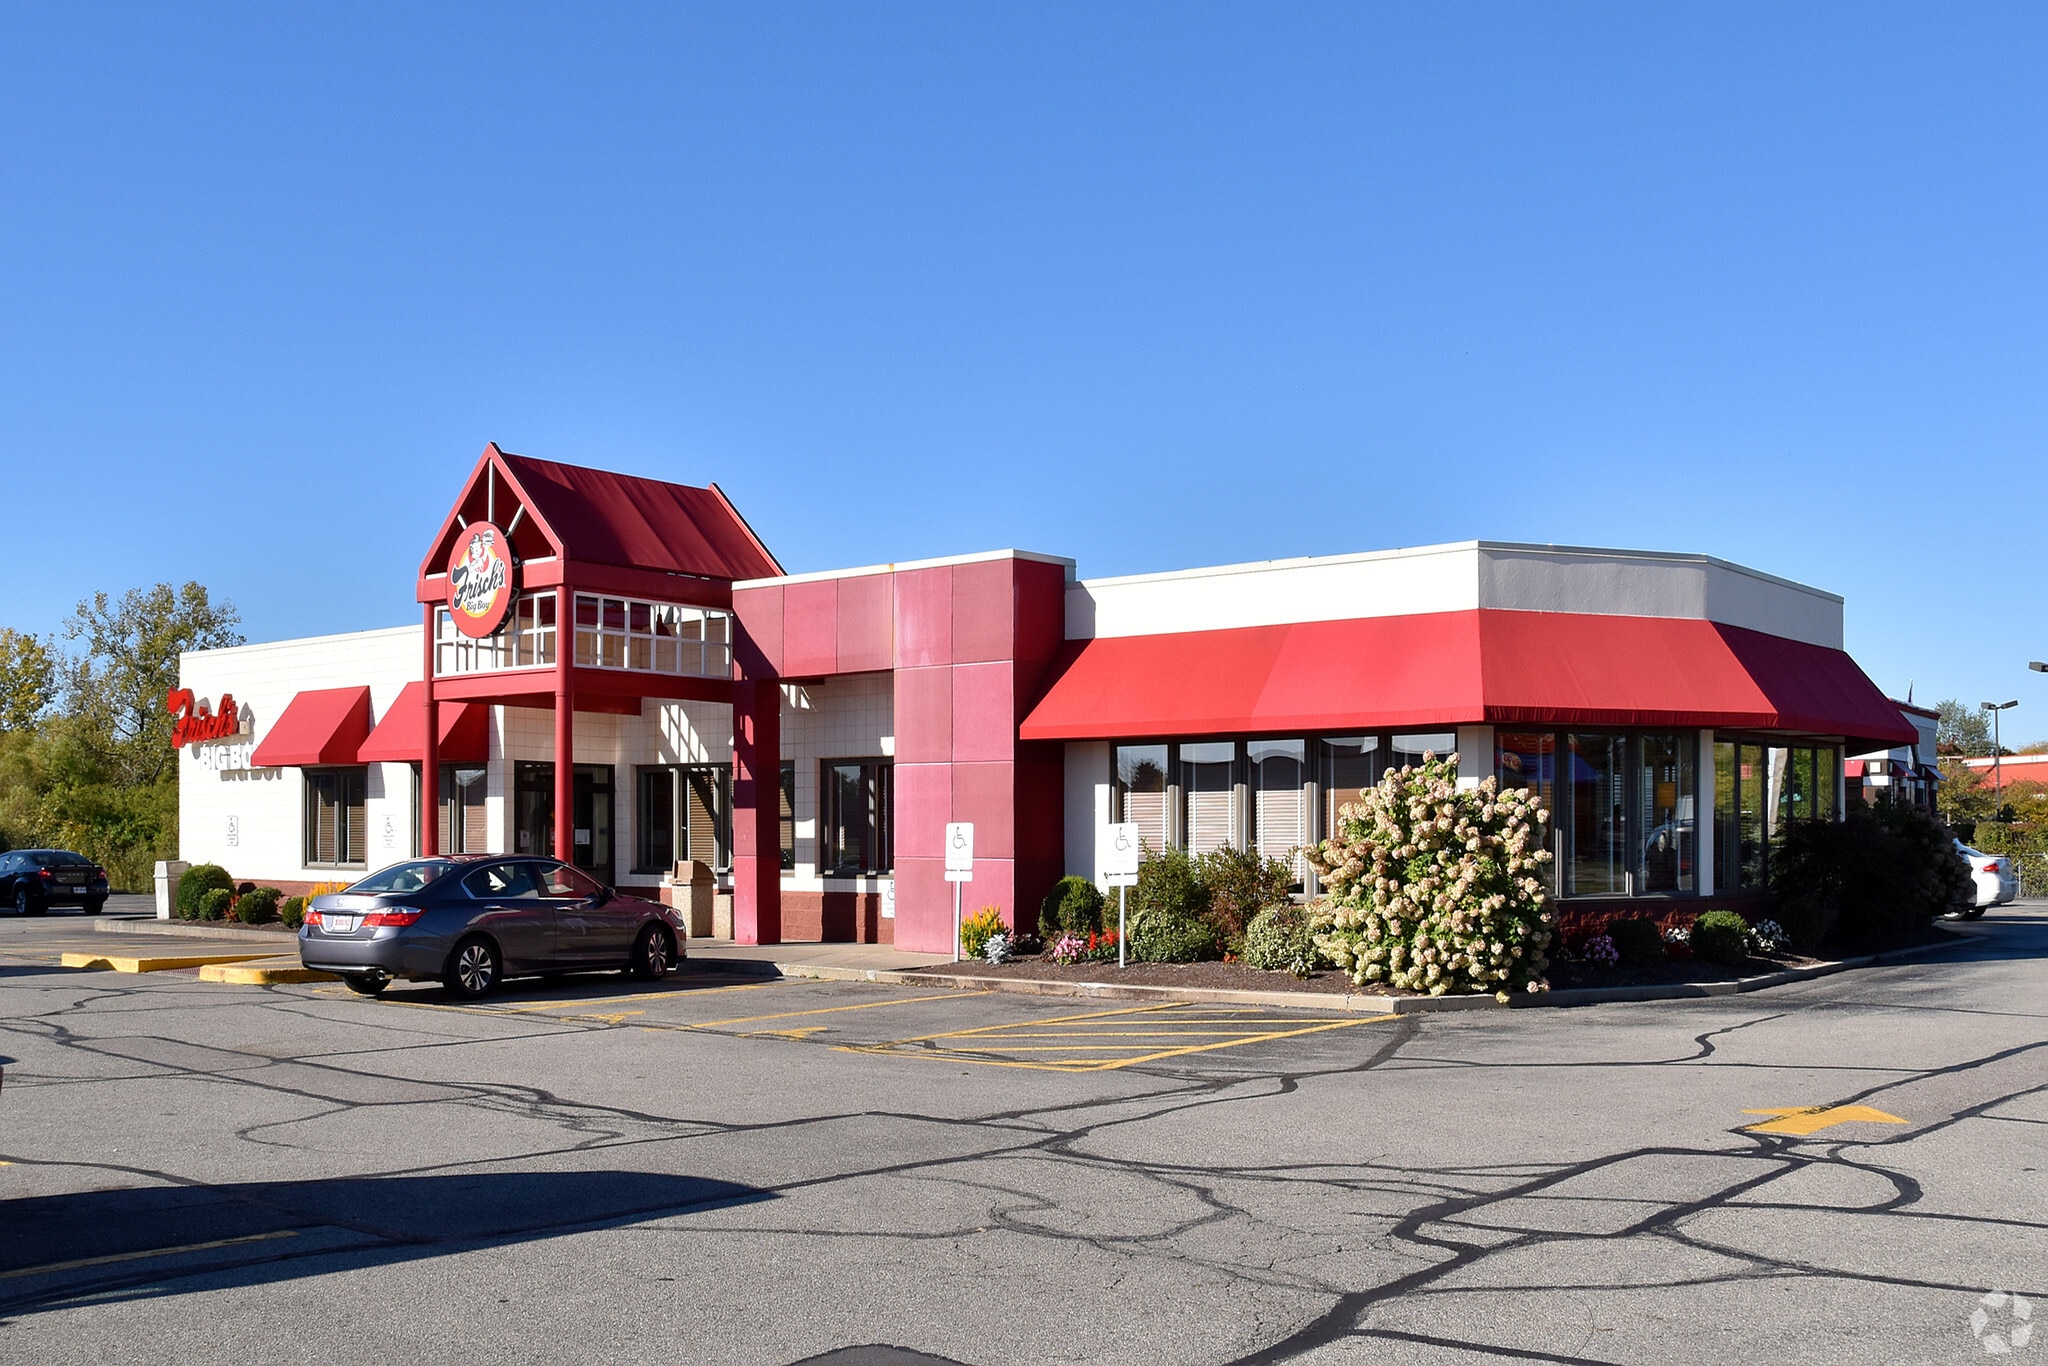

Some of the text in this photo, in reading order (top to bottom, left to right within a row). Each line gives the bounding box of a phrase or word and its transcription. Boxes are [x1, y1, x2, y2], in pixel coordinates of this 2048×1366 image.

[452, 559, 504, 608] Frisch's
[466, 599, 490, 613] Big Boy
[167, 686, 239, 749] Frisch's
[200, 742, 256, 770] BIG BO
